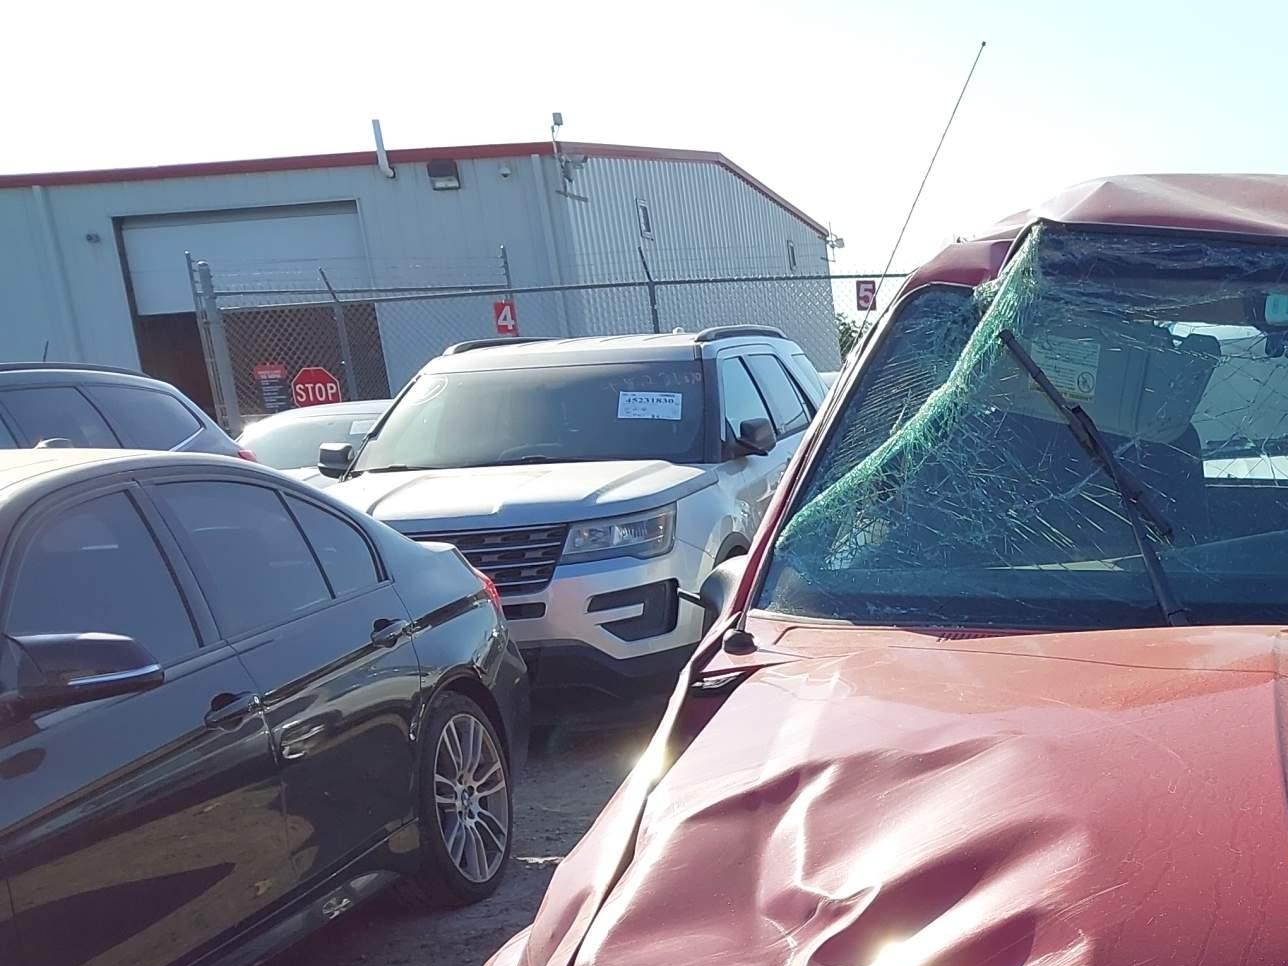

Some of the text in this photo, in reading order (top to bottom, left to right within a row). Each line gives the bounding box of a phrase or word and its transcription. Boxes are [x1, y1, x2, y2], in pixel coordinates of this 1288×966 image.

[859, 283, 874, 308] 5
[497, 305, 515, 330] 4
[295, 382, 337, 402] STOP
